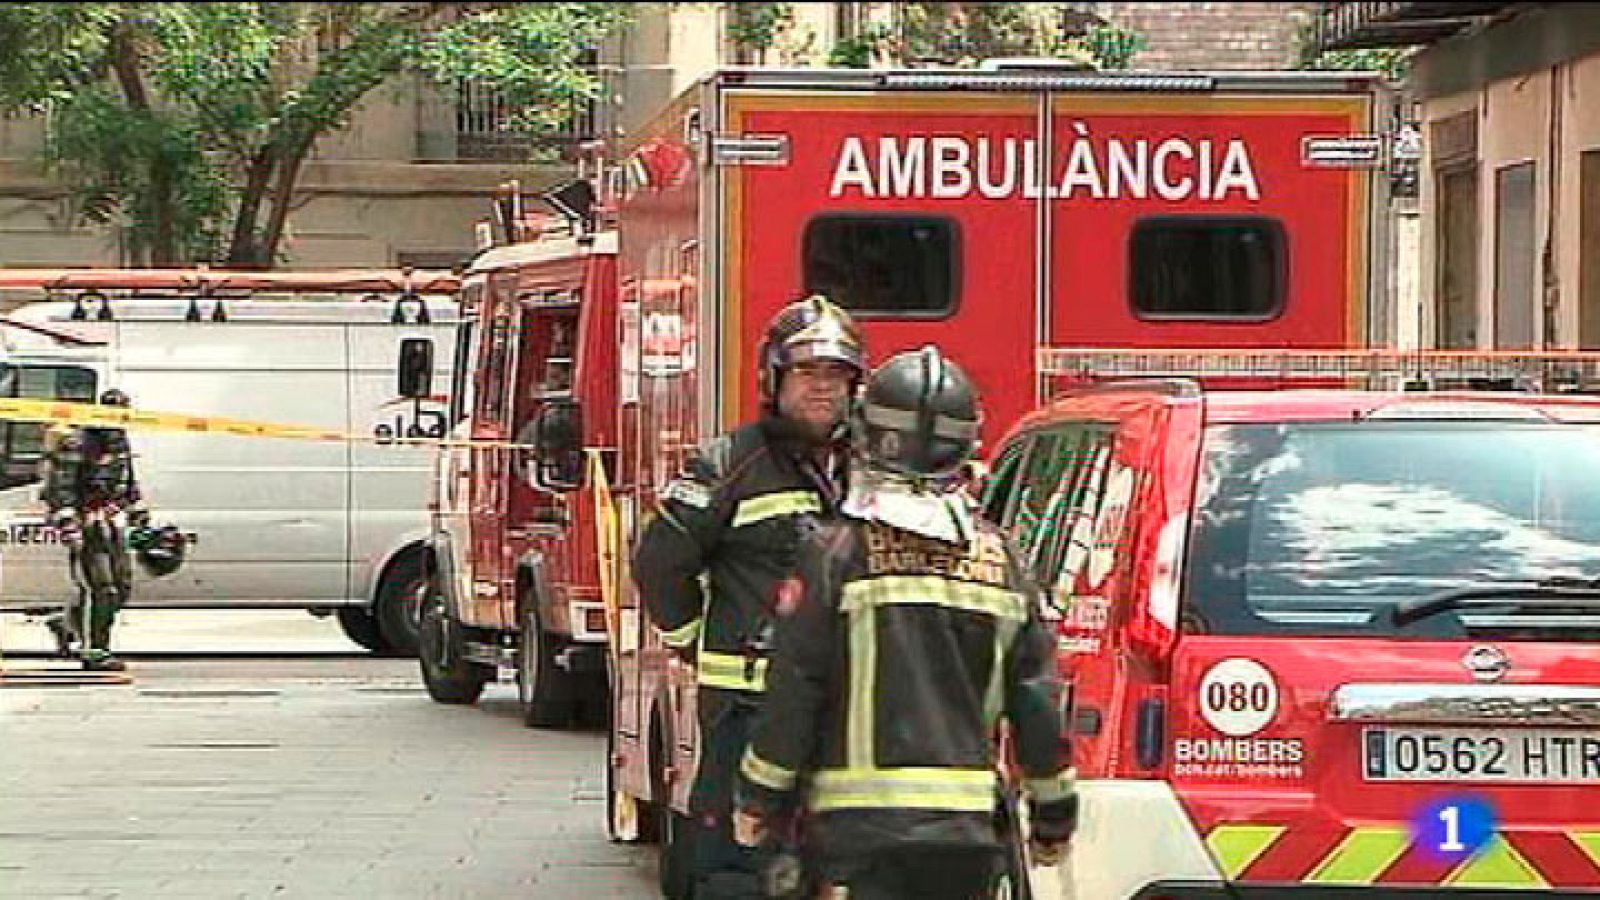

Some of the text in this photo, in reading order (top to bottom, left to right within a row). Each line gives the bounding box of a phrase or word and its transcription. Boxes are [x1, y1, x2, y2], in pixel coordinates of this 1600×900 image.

[829, 120, 1260, 200] AMBULÀNCIA
[1207, 681, 1269, 712] 080
[1175, 738, 1302, 763] BOMBERS
[1395, 735, 1600, 777] 0562 HTR
